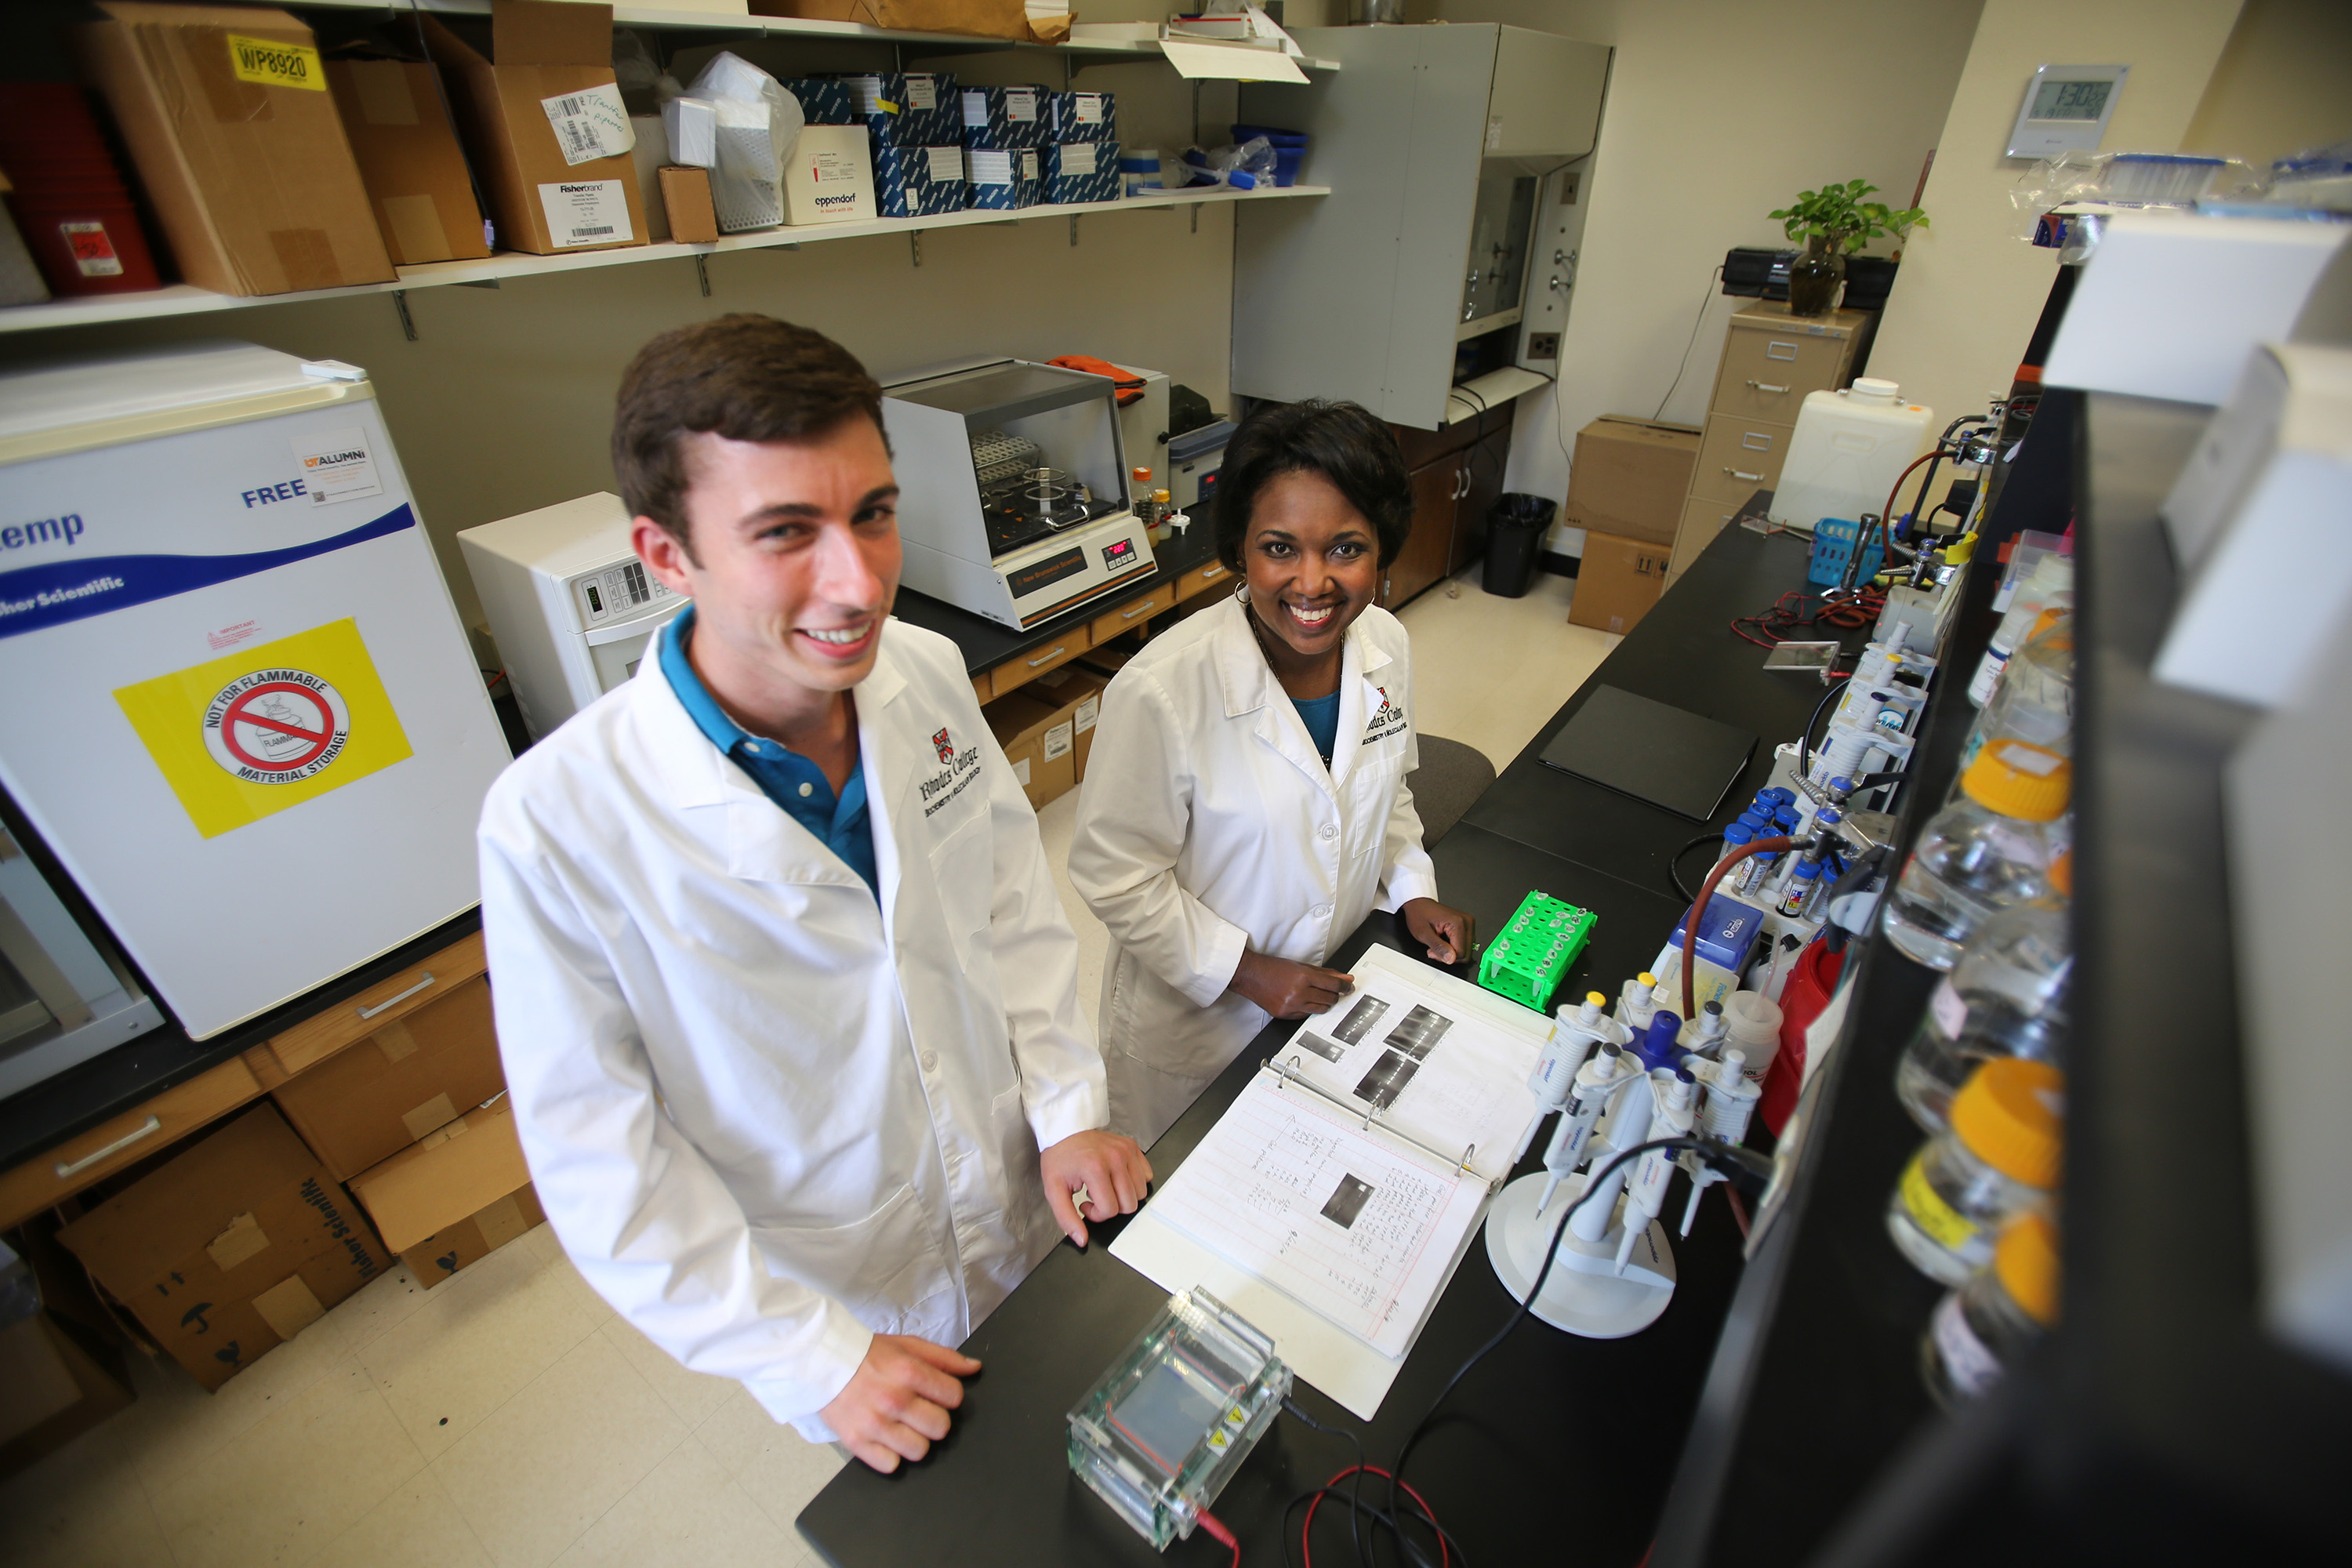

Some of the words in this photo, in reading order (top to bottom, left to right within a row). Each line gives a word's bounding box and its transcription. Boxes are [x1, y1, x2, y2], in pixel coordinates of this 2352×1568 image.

[238, 47, 307, 77] WP8920
[561, 183, 603, 193] Fisherbrand
[815, 193, 856, 208] eppendorf
[0, 514, 85, 552] emp
[1034, 564, 1061, 578] Brunswick
[1059, 555, 1082, 568] Scientific
[37, 576, 125, 606] Scientific
[220, 620, 256, 634] IMPORTANT
[205, 705, 224, 728] NOT
[217, 684, 242, 705] FOR
[240, 670, 328, 693] FLAMMABLE
[263, 734, 299, 748] FLAMMA
[237, 766, 307, 783] MATERIAL
[307, 730, 347, 774] STORAGE
[919, 769, 953, 802] Rhodes
[952, 746, 978, 776] College
[1544, 1058, 1556, 1083] eppendorf
[300, 1177, 350, 1239] Scientific
[343, 1237, 379, 1279] Fisher
